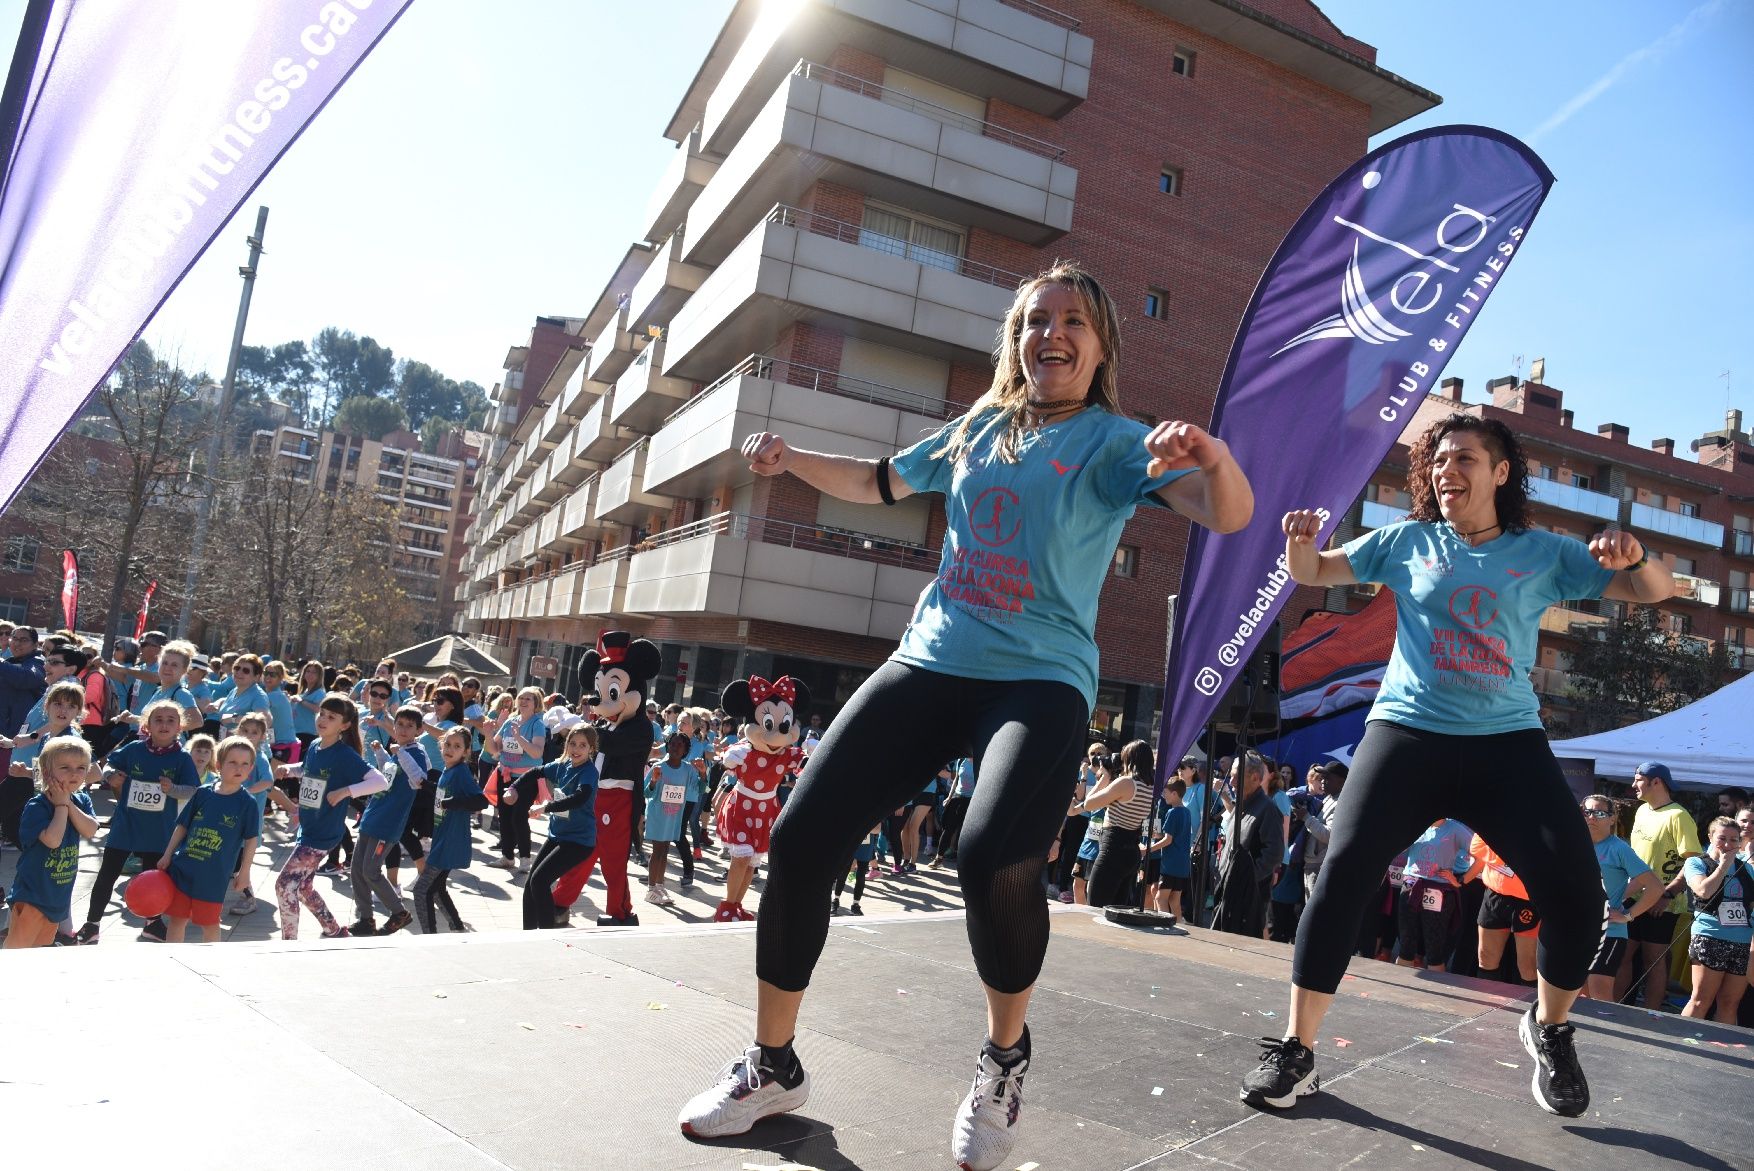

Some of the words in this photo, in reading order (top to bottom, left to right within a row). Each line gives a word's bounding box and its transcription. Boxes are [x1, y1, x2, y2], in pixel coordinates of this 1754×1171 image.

[1379, 361, 1429, 422] CLUB
[1428, 338, 1448, 352] &
[1444, 225, 1524, 329] FITNESS
[968, 550, 1028, 579] CURSA
[978, 571, 1035, 601] DONA
[1433, 627, 1455, 642] VII
[1429, 641, 1446, 656] DE
[1449, 643, 1469, 659] LA
[1433, 656, 1511, 679] MANRESA
[133, 790, 162, 805] 1029
[301, 787, 319, 801] 1023
[1423, 895, 1436, 905] 26
